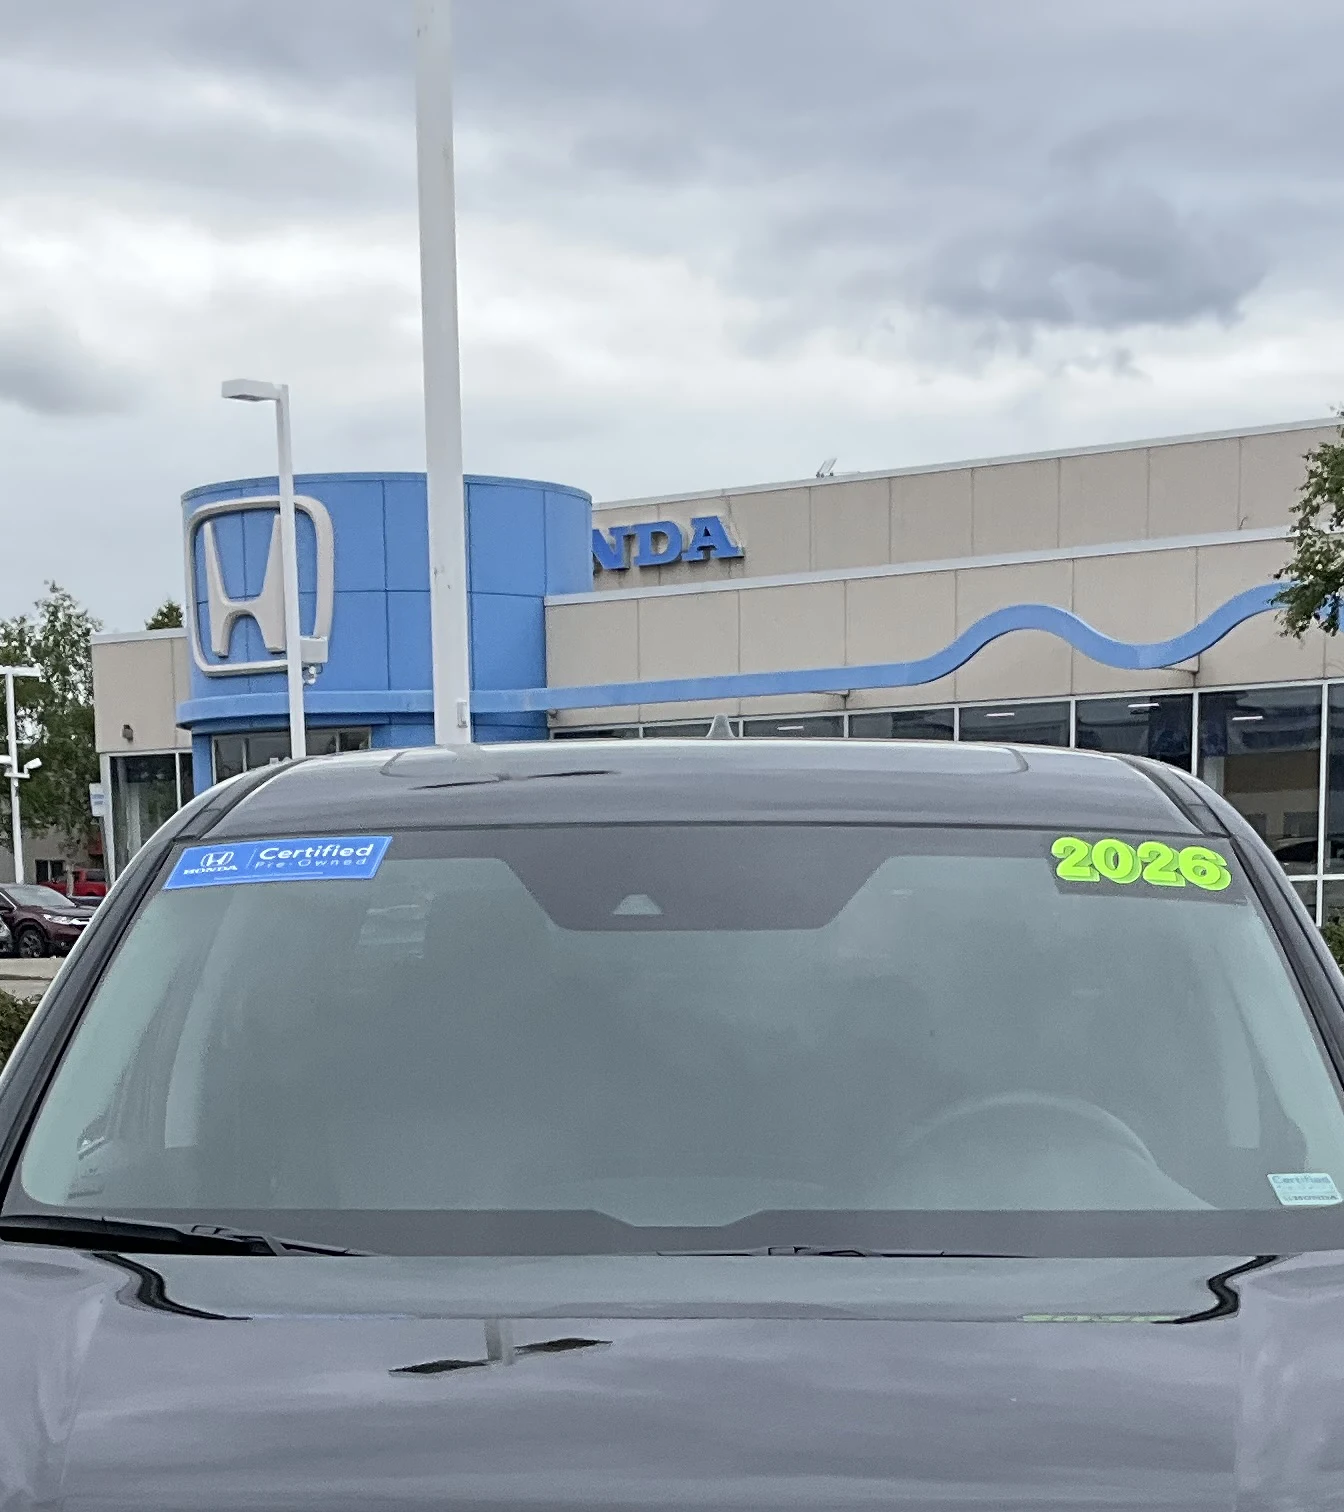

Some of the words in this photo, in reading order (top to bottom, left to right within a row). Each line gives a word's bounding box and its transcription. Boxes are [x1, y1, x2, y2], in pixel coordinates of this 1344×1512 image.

[592, 515, 743, 570] NDA
[259, 843, 374, 860] Certified
[1051, 837, 1232, 891] 2026
[183, 865, 238, 875] HONDA
